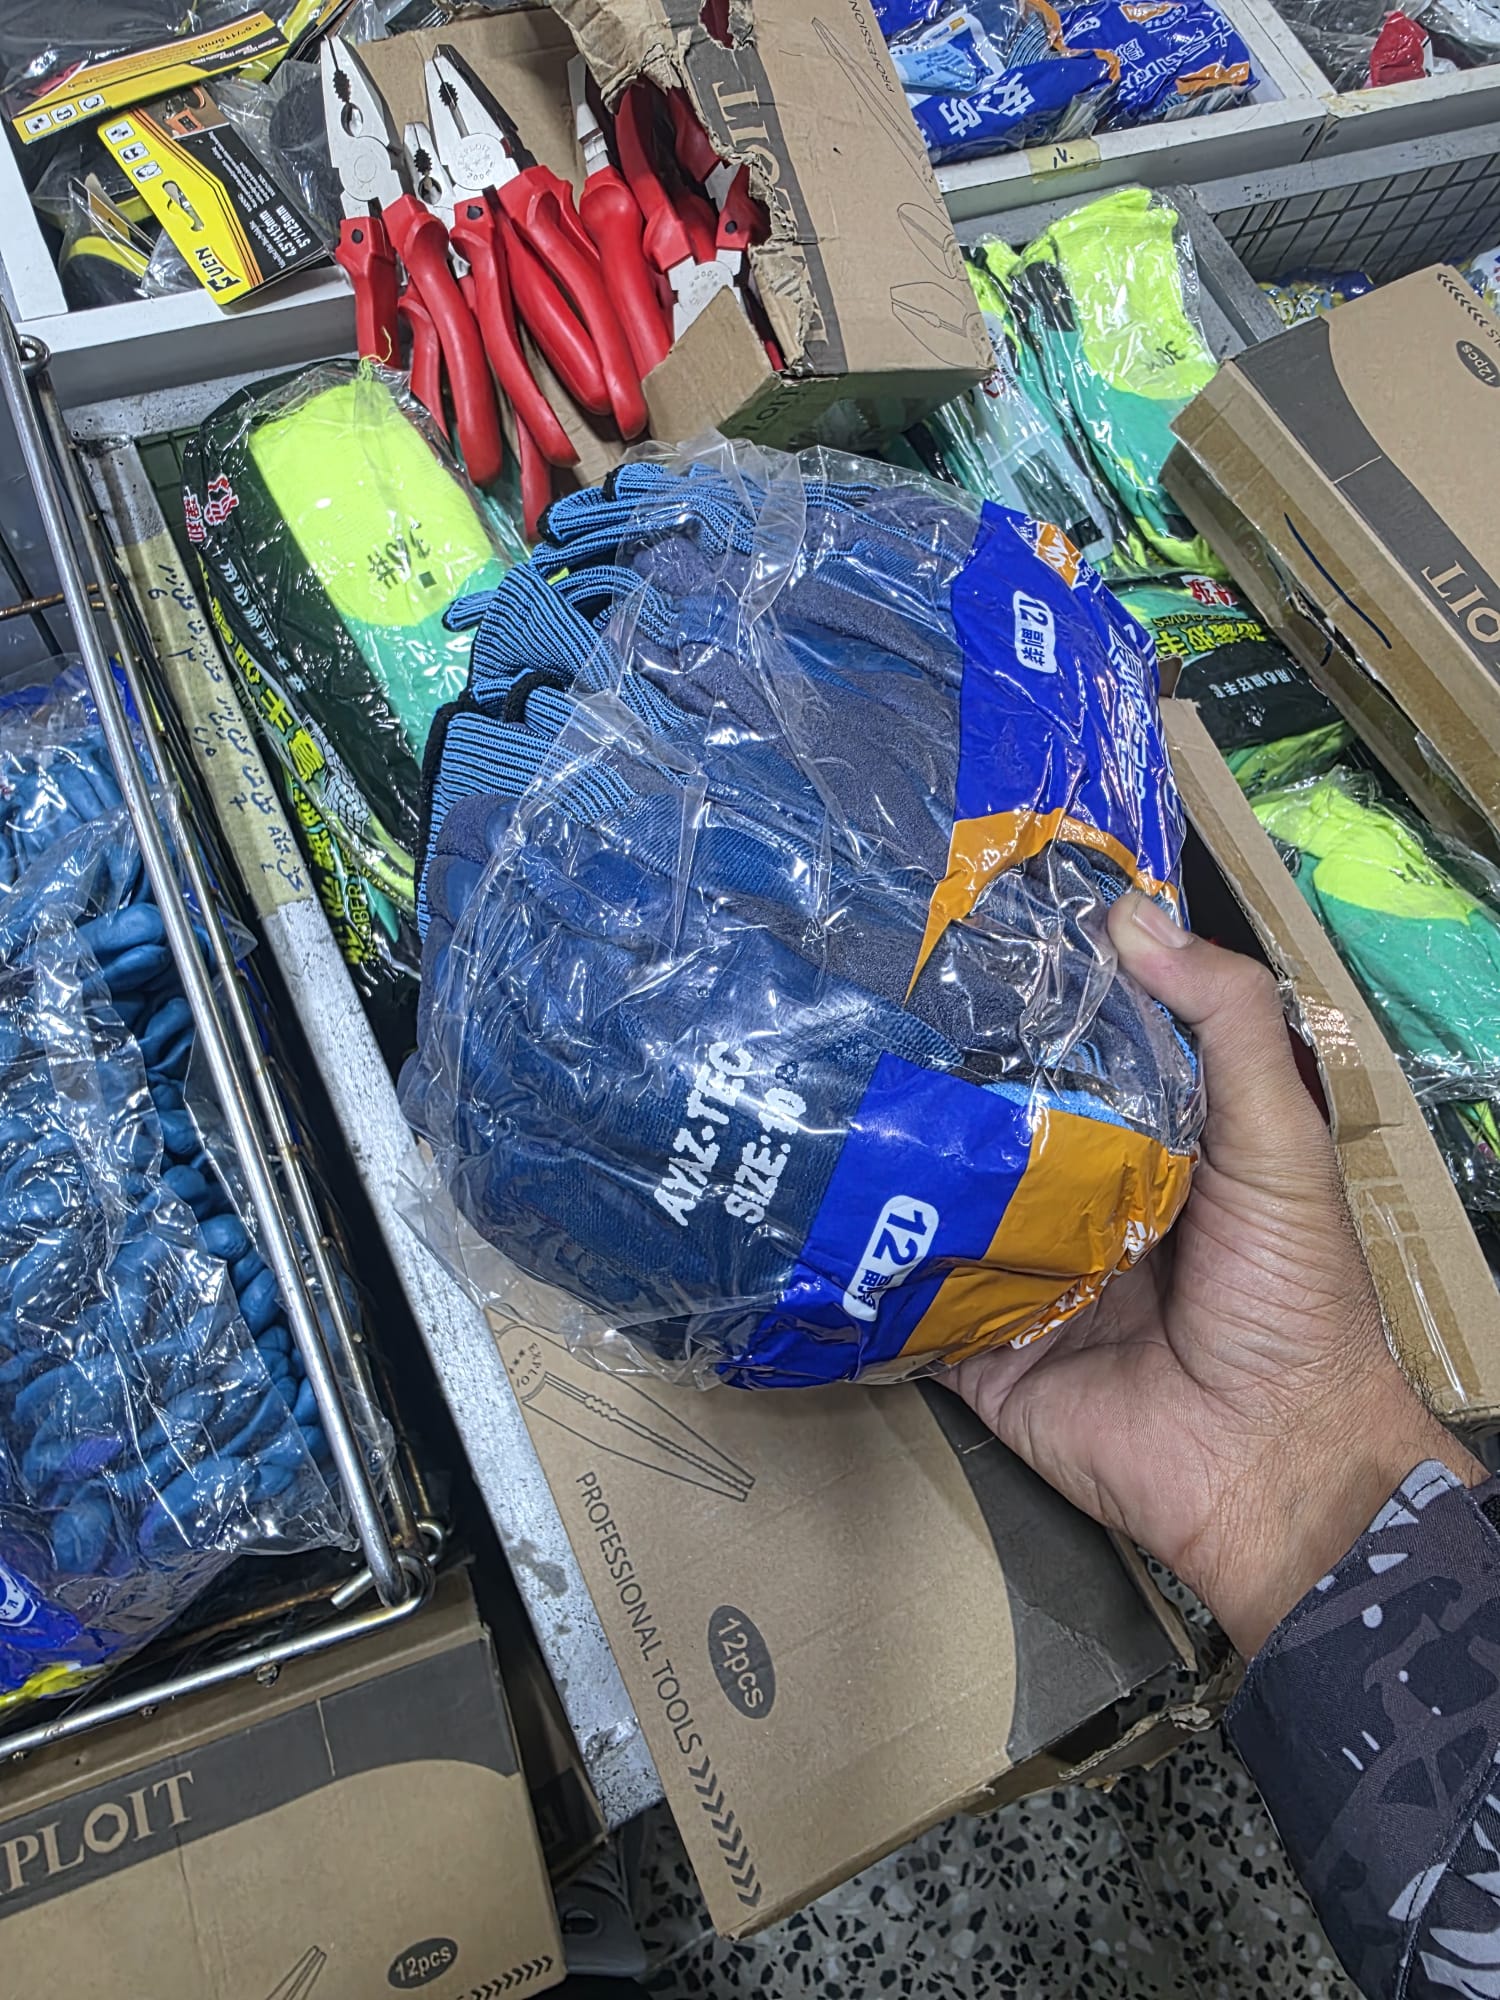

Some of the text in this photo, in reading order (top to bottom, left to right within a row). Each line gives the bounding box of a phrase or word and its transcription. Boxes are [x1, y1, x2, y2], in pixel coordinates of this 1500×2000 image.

[848, 0, 895, 93] PROFESSION
[1461, 343, 1498, 385] 12pcs
[575, 1470, 703, 1755] PROFESSIONAL TOOLS
[711, 1615, 764, 1710] 12pcs
[0, 1770, 194, 1895] PLOIT
[394, 1943, 453, 1983] 12pcs
